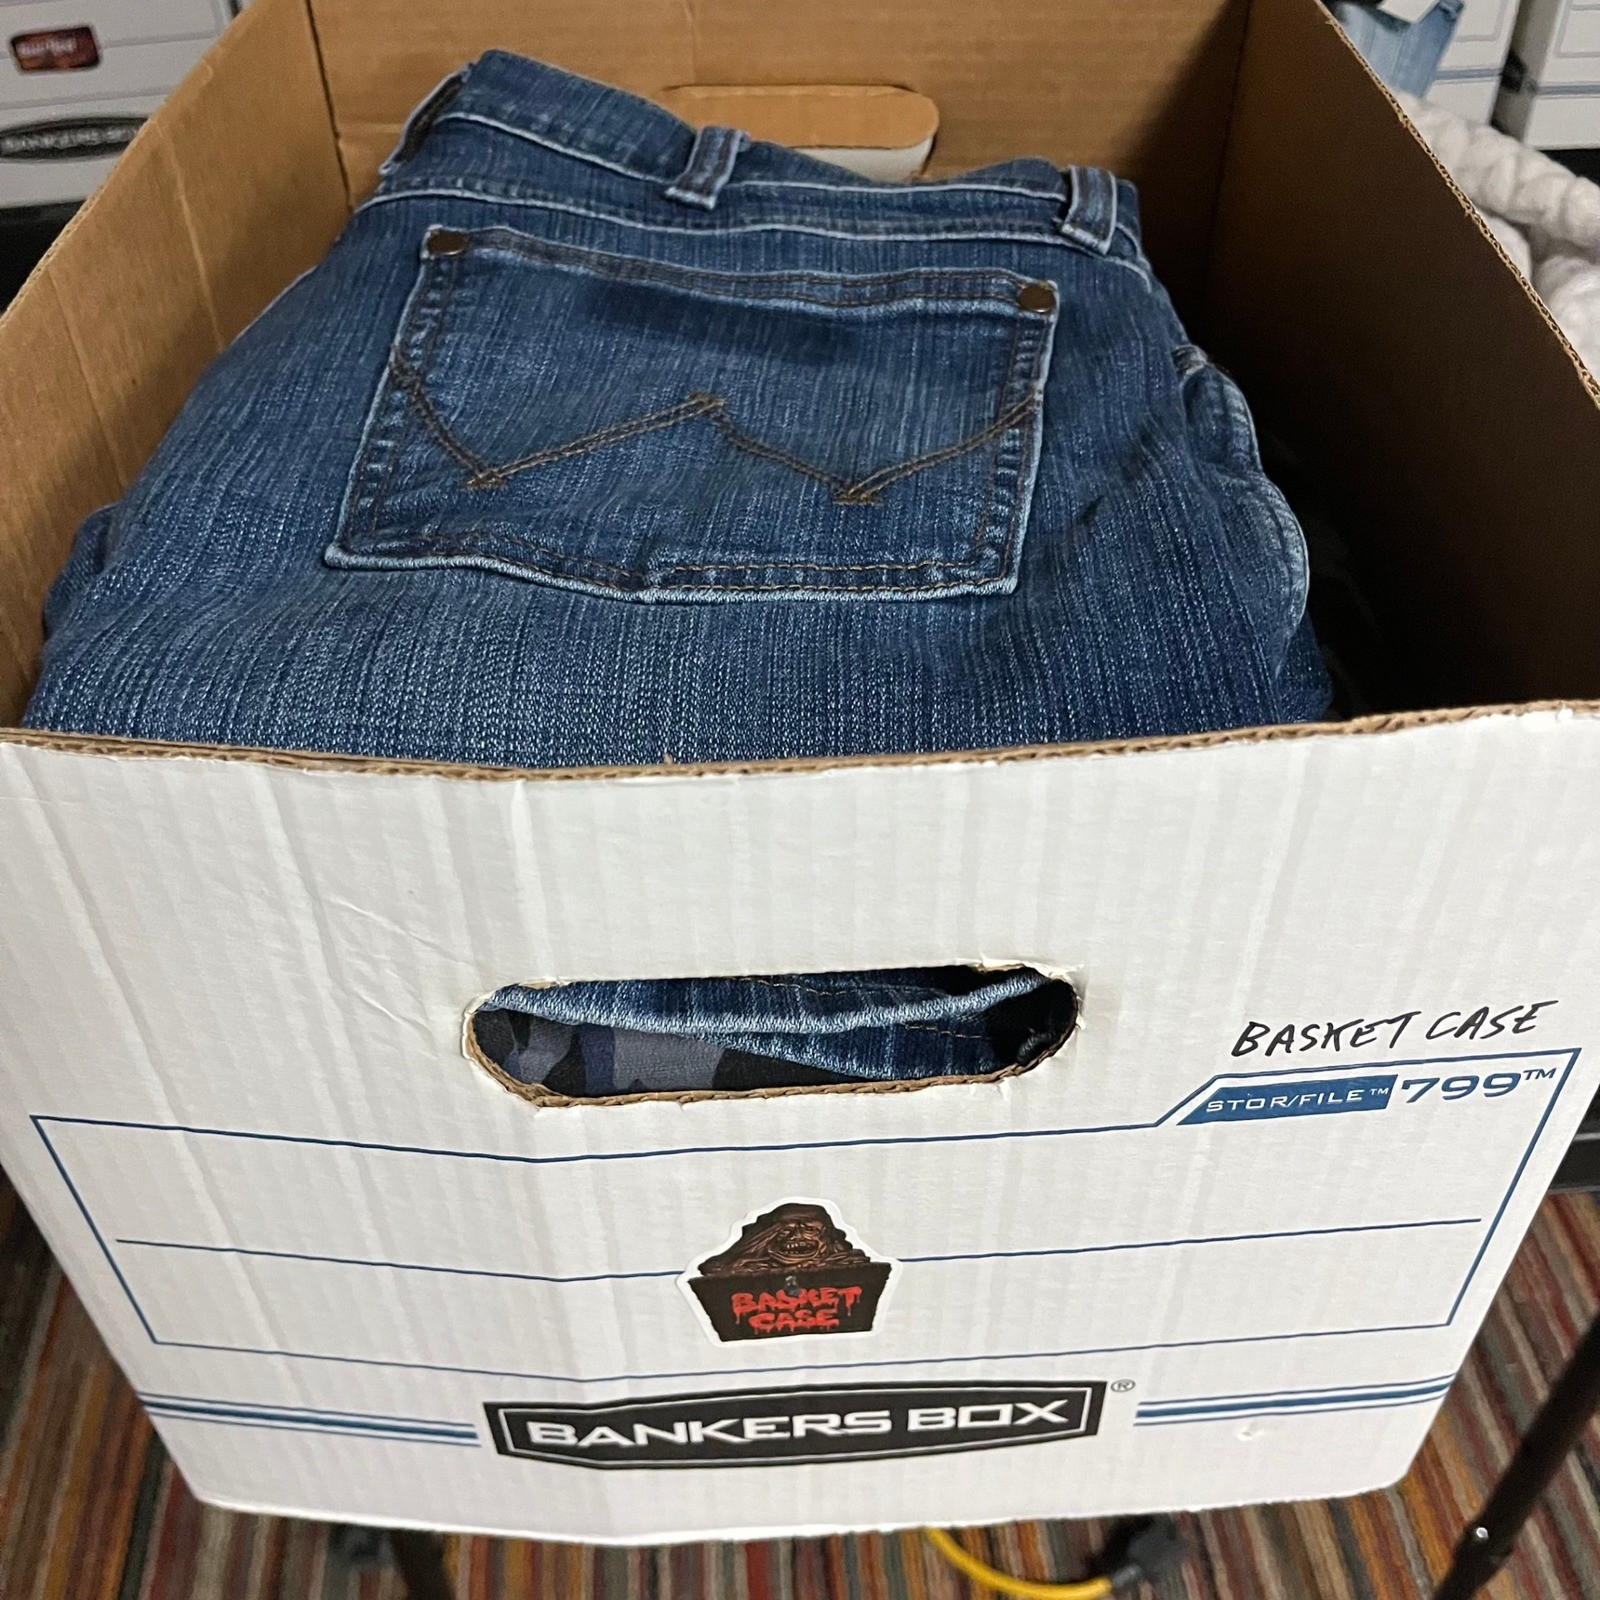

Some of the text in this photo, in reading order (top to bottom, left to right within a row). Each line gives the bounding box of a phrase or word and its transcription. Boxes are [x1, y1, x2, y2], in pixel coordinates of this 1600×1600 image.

[1230, 1000, 1559, 1057] BASKET CASE
[731, 1285, 863, 1322] BASKET
[748, 1307, 840, 1334] CASE
[526, 1399, 1069, 1447] BANKERS BOX
